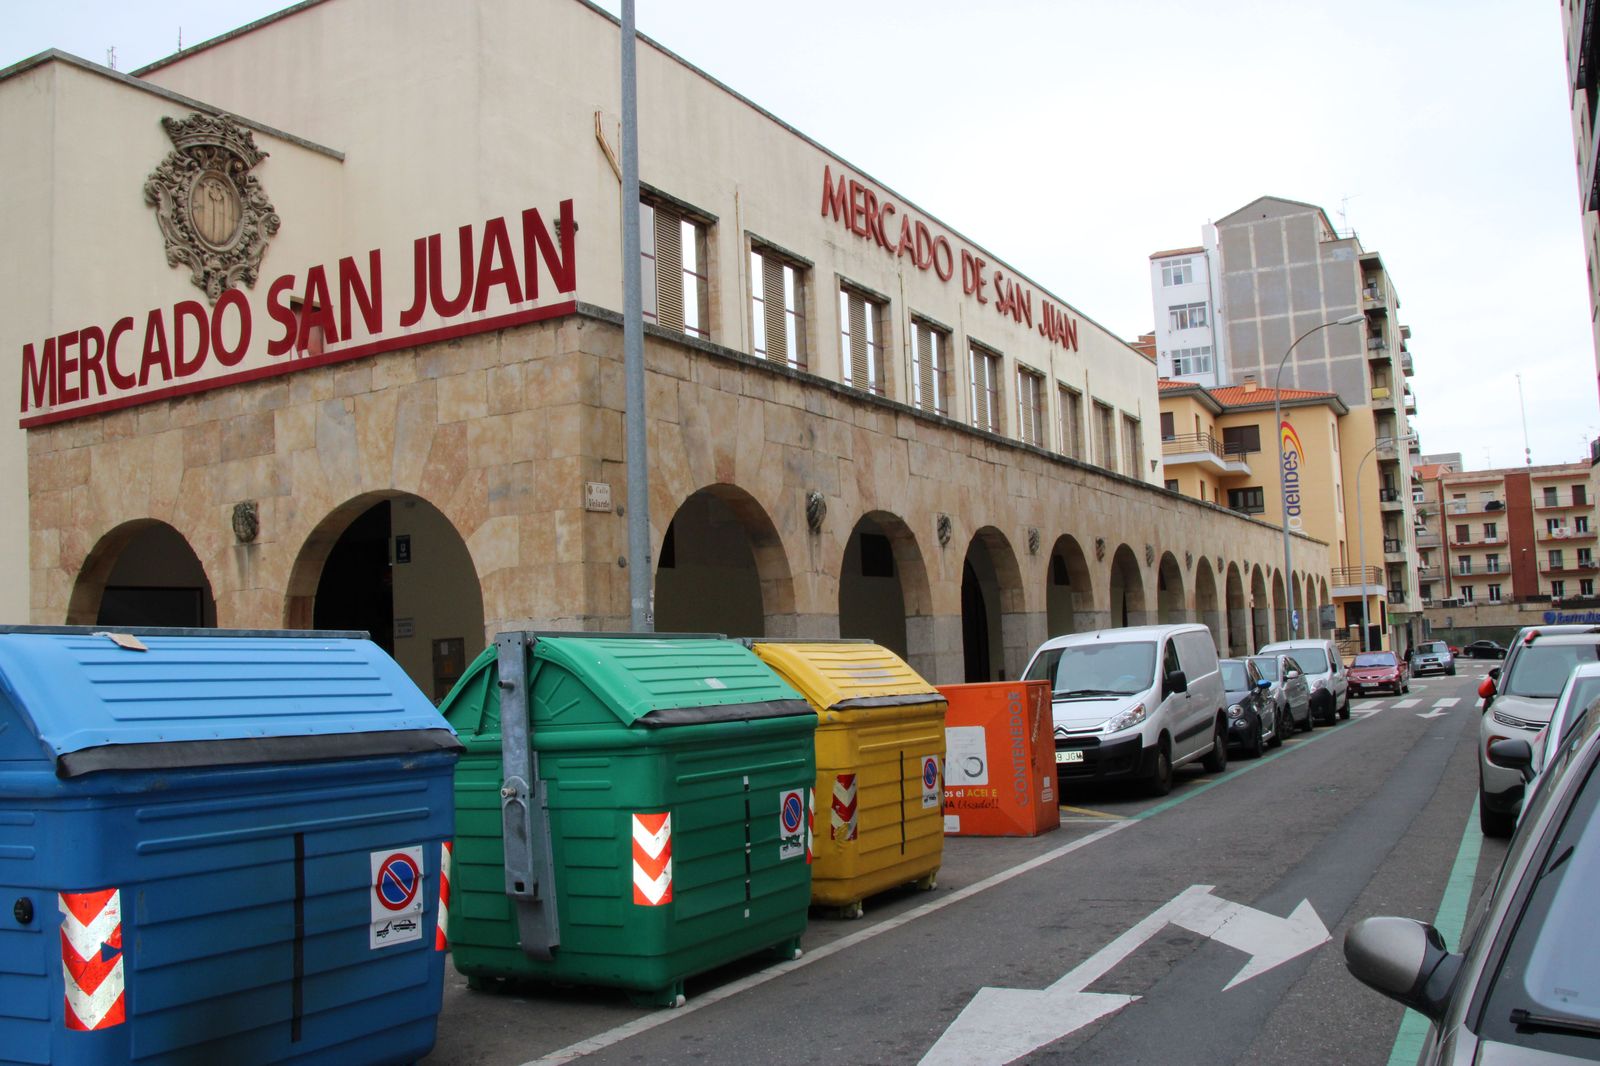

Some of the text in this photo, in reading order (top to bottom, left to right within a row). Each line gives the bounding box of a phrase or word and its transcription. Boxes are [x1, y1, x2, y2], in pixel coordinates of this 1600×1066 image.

[20, 198, 577, 413] MERCADO SAN JUAN
[821, 165, 1078, 352] MERCADO DE SAN JUAN
[955, 789, 965, 798] el
[1008, 691, 1028, 808] CONTENEDOR
